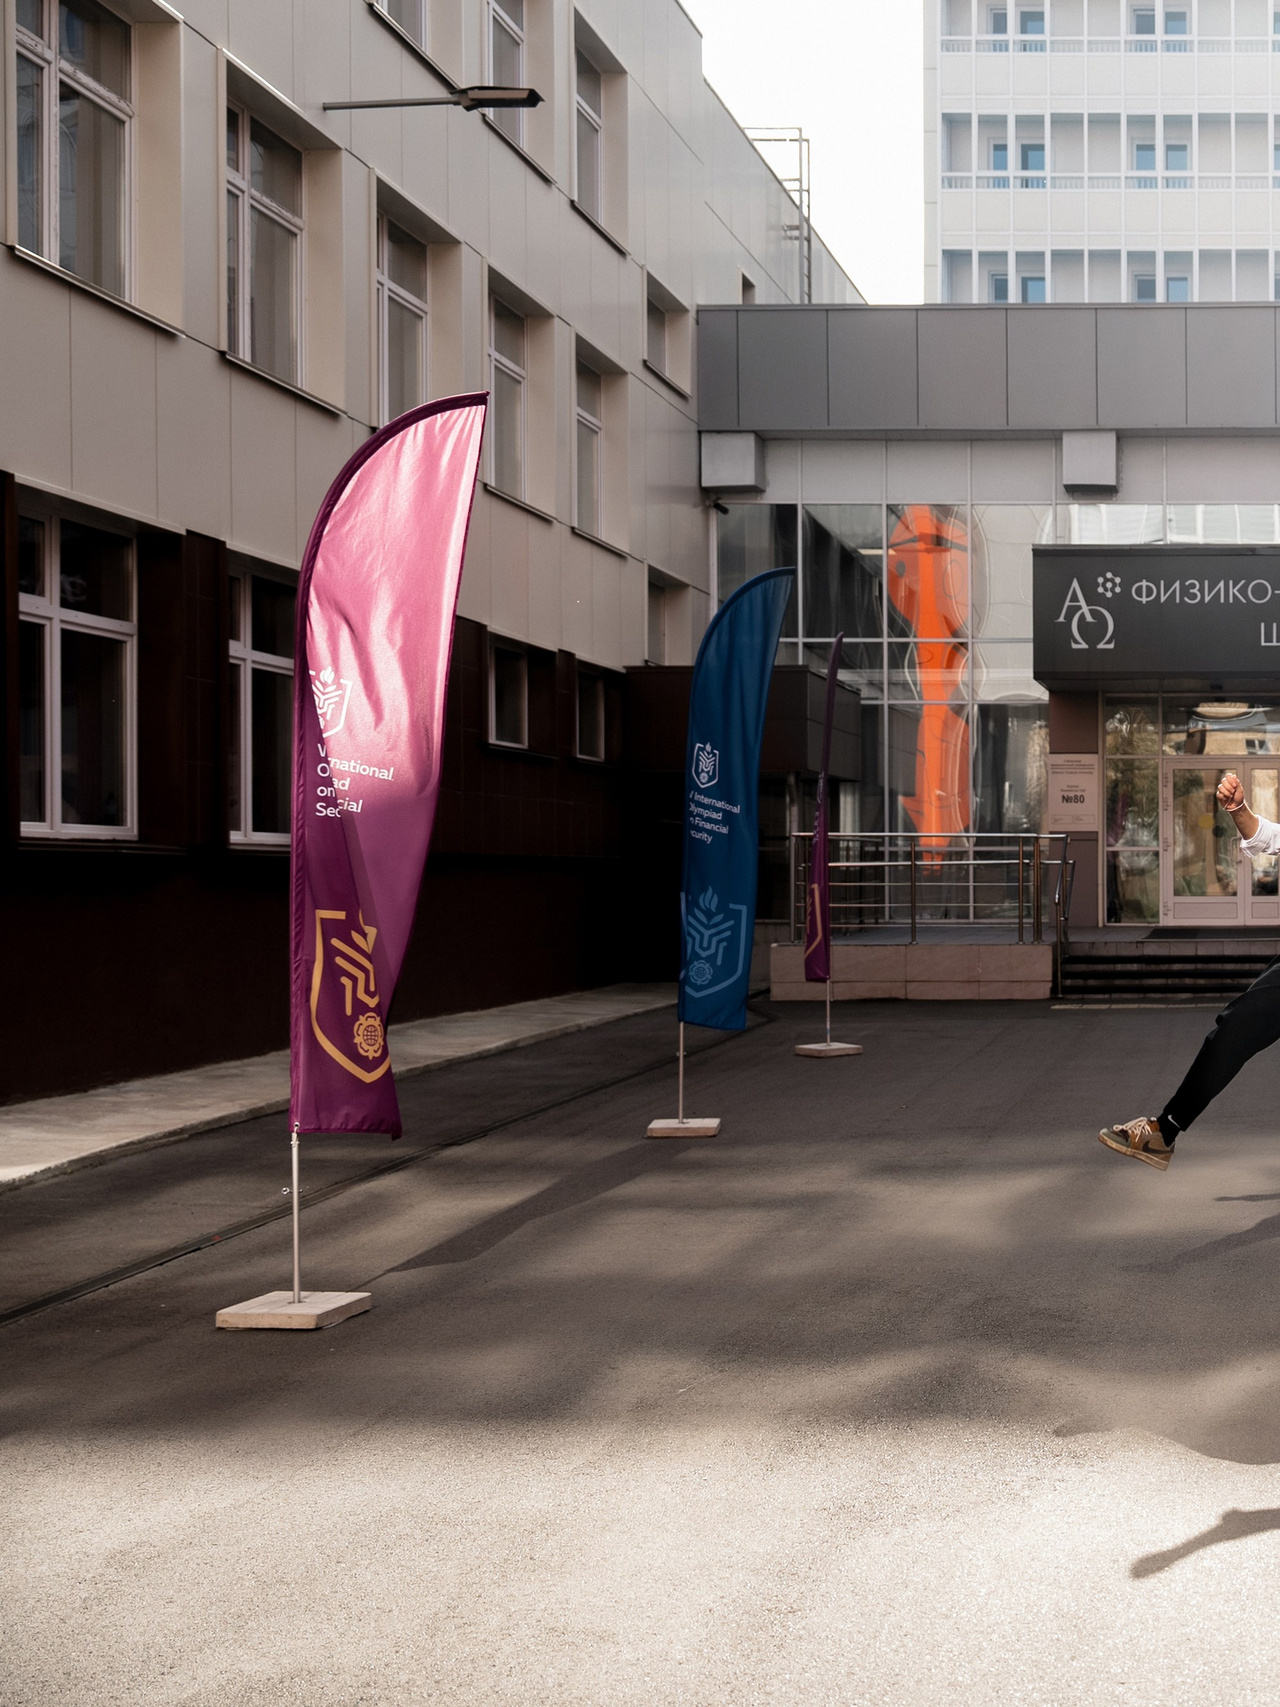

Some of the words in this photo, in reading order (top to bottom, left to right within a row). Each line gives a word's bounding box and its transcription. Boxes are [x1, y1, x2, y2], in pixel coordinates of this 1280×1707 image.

[694, 791, 741, 814] International
[1061, 794, 1085, 804] №80
[695, 816, 729, 834] Financial
